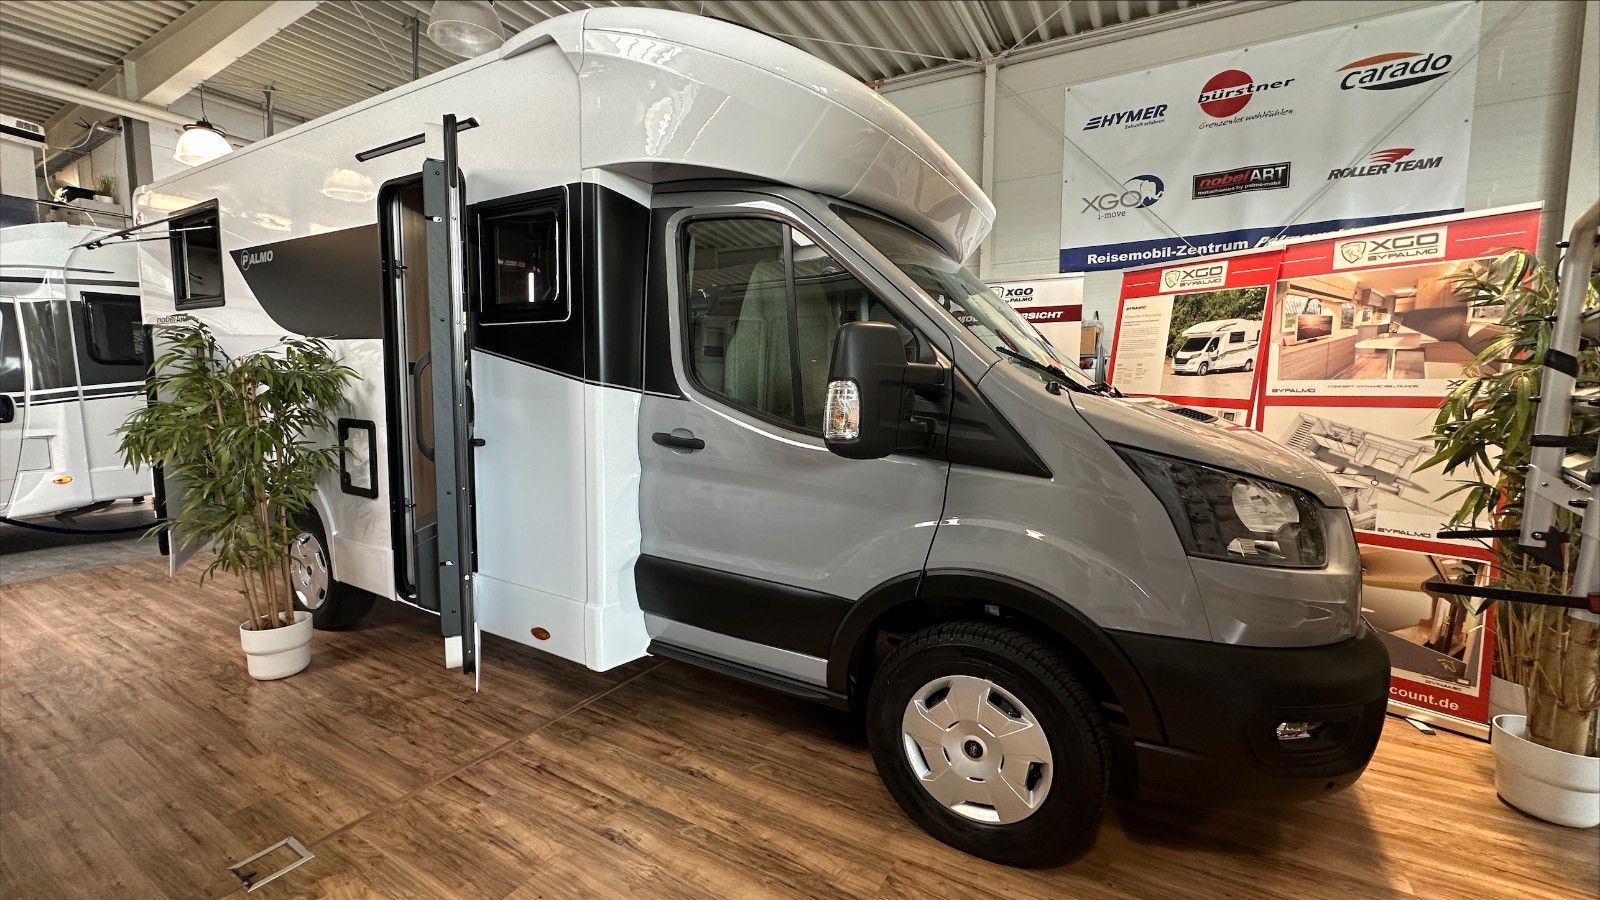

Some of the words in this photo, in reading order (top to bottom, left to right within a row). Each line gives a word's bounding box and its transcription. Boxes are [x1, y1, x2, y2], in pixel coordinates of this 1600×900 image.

[1340, 53, 1453, 91] carado
[1198, 78, 1296, 104] bürstner
[1100, 104, 1168, 128] HYMER
[1199, 117, 1243, 130] Grenzenlos
[1245, 107, 1294, 122] wohlfühlen
[1199, 166, 1287, 187] nobelART
[1327, 163, 1391, 181] ROLLER
[1394, 156, 1443, 173] TEAM
[1081, 190, 1142, 213] XGO
[1197, 186, 1235, 196] motorhomes
[1097, 210, 1126, 220] i-move
[1087, 239, 1249, 265] Reisemobil-Zentrum
[1368, 232, 1440, 252] XGO
[241, 250, 274, 270] PALMO
[1181, 265, 1223, 279] XGO
[1004, 287, 1034, 297] XGO
[1389, 686, 1460, 711] count.de
